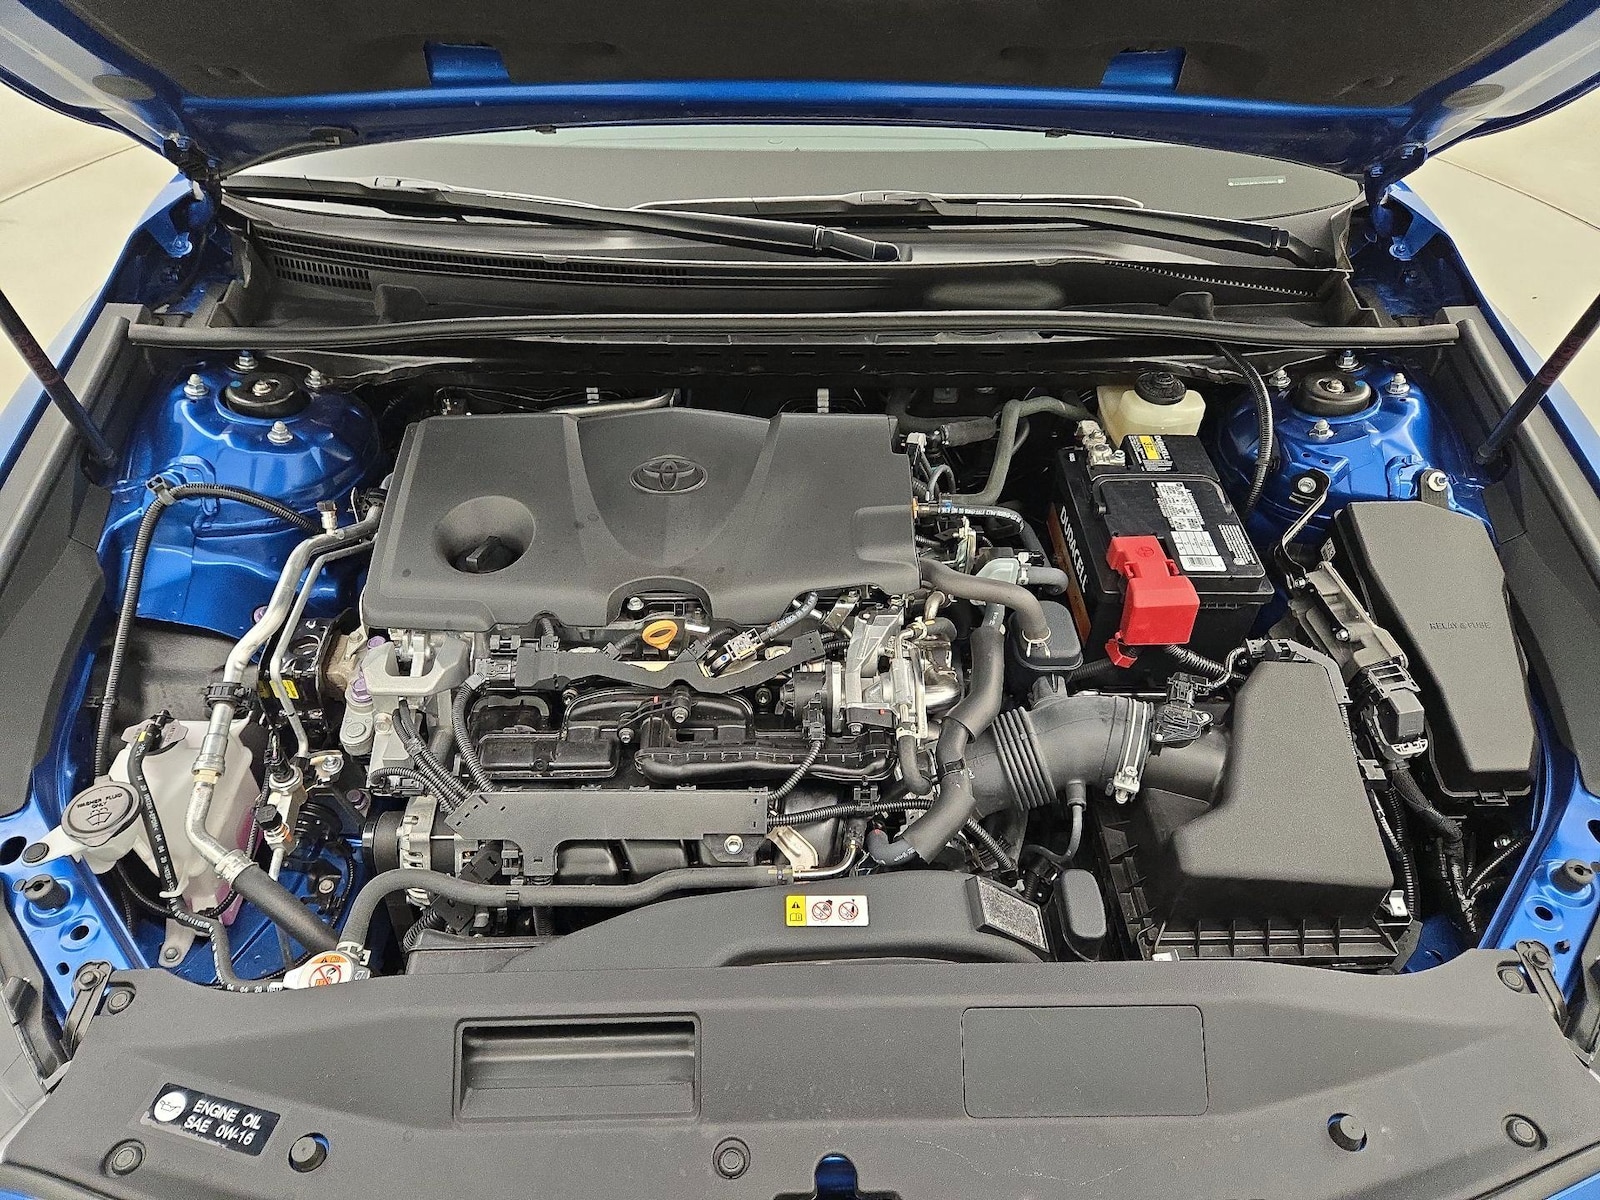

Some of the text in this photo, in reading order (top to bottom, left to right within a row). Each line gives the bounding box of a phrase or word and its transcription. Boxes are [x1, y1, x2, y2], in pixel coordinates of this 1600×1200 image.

[1060, 505, 1087, 593] DURACELL
[1429, 622, 1458, 630] RELAY
[193, 1100, 262, 1130] ENGINE OIL
[184, 1115, 256, 1146] SAE 0W-16
